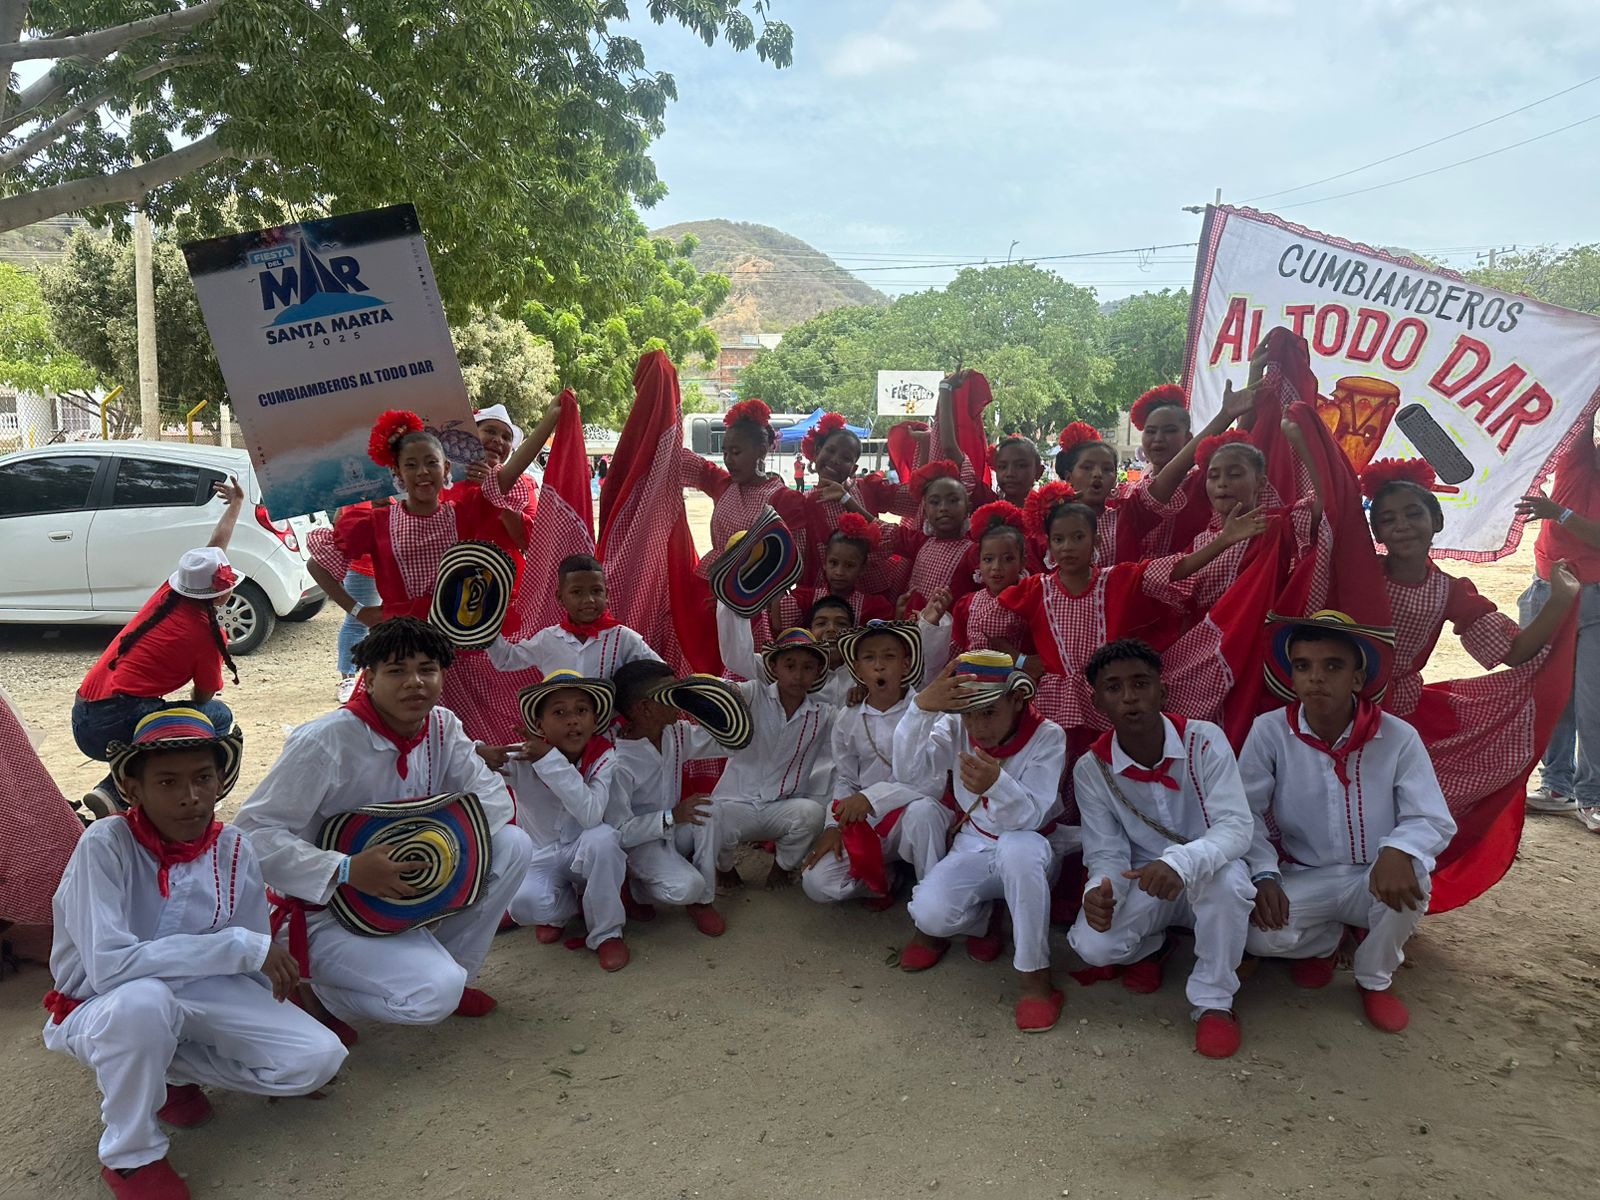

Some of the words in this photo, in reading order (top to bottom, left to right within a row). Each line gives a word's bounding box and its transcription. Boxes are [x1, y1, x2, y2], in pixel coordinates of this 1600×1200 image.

[253, 248, 292, 263] FIESTA
[258, 236, 370, 311] MAR
[267, 260, 283, 268] DEL
[1278, 243, 1524, 333] CUMBIAMBEROS
[265, 321, 327, 345] SANTA
[332, 308, 394, 333] MARTA
[308, 331, 361, 349] 2025
[258, 375, 358, 407] CUMBIAMBEROS
[359, 372, 374, 387] AL
[374, 364, 408, 383] TODO
[408, 359, 434, 377] DAR
[1285, 303, 1429, 372] TODO
[1427, 334, 1554, 456] DAR
